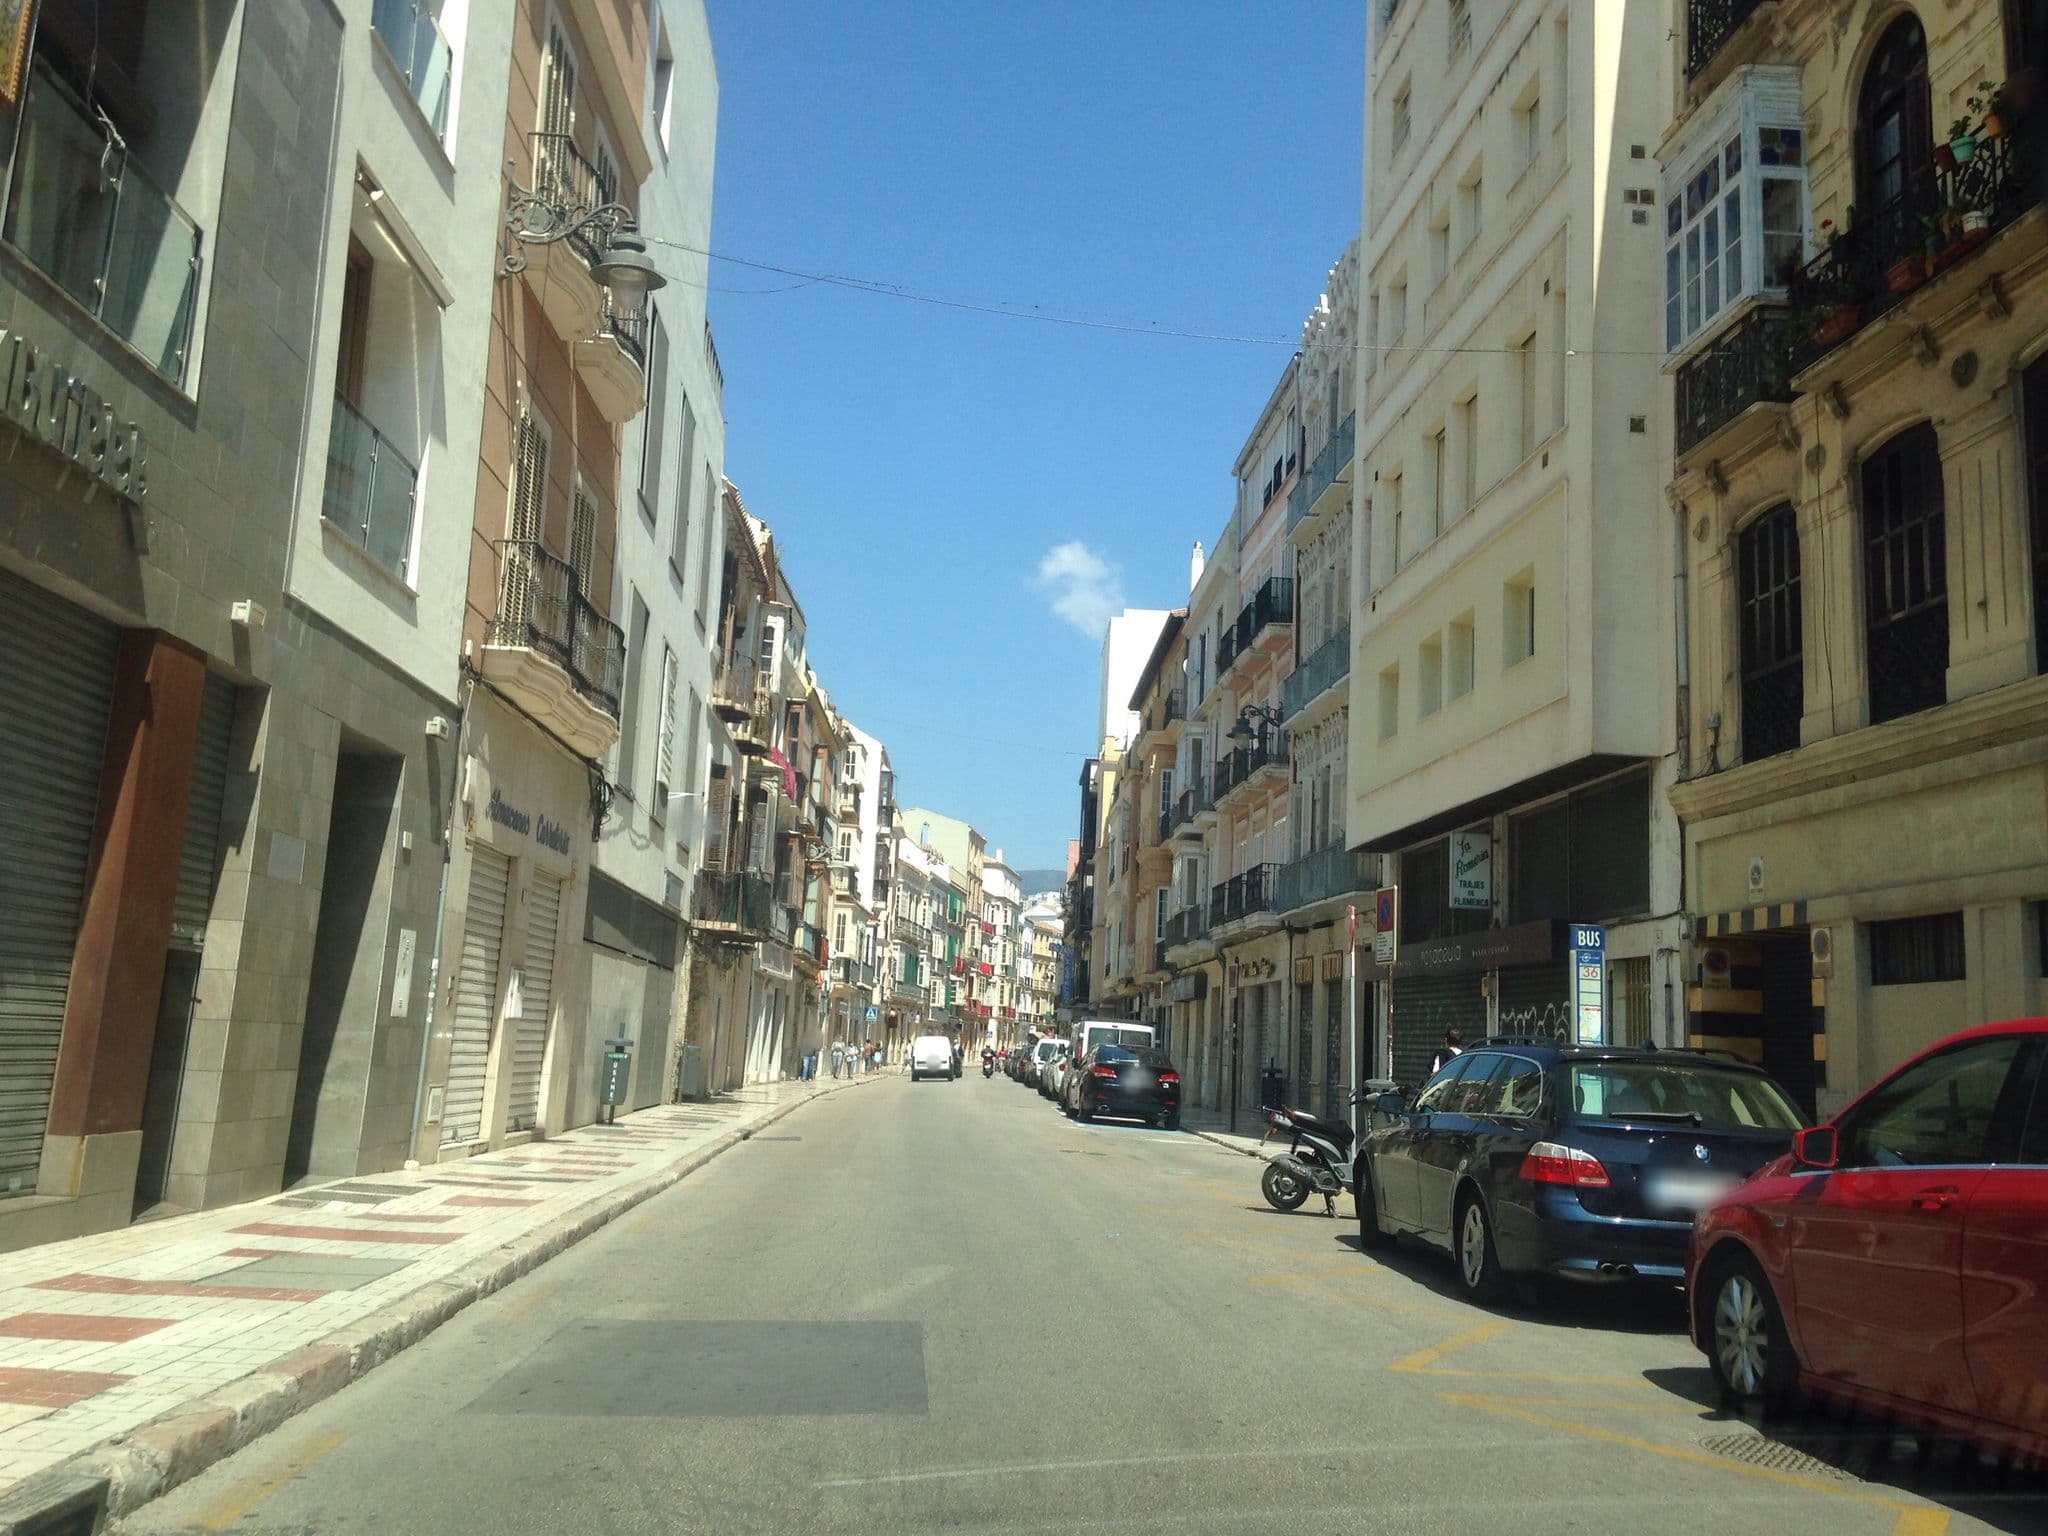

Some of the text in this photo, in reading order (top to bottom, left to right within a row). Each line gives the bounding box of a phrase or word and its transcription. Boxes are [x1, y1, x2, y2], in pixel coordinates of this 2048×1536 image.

[1459, 880, 1485, 890] TRAJES
[1454, 898, 1489, 907] FLAMENCA
[1577, 930, 1601, 947] BUS
[1583, 967, 1599, 978] 36
